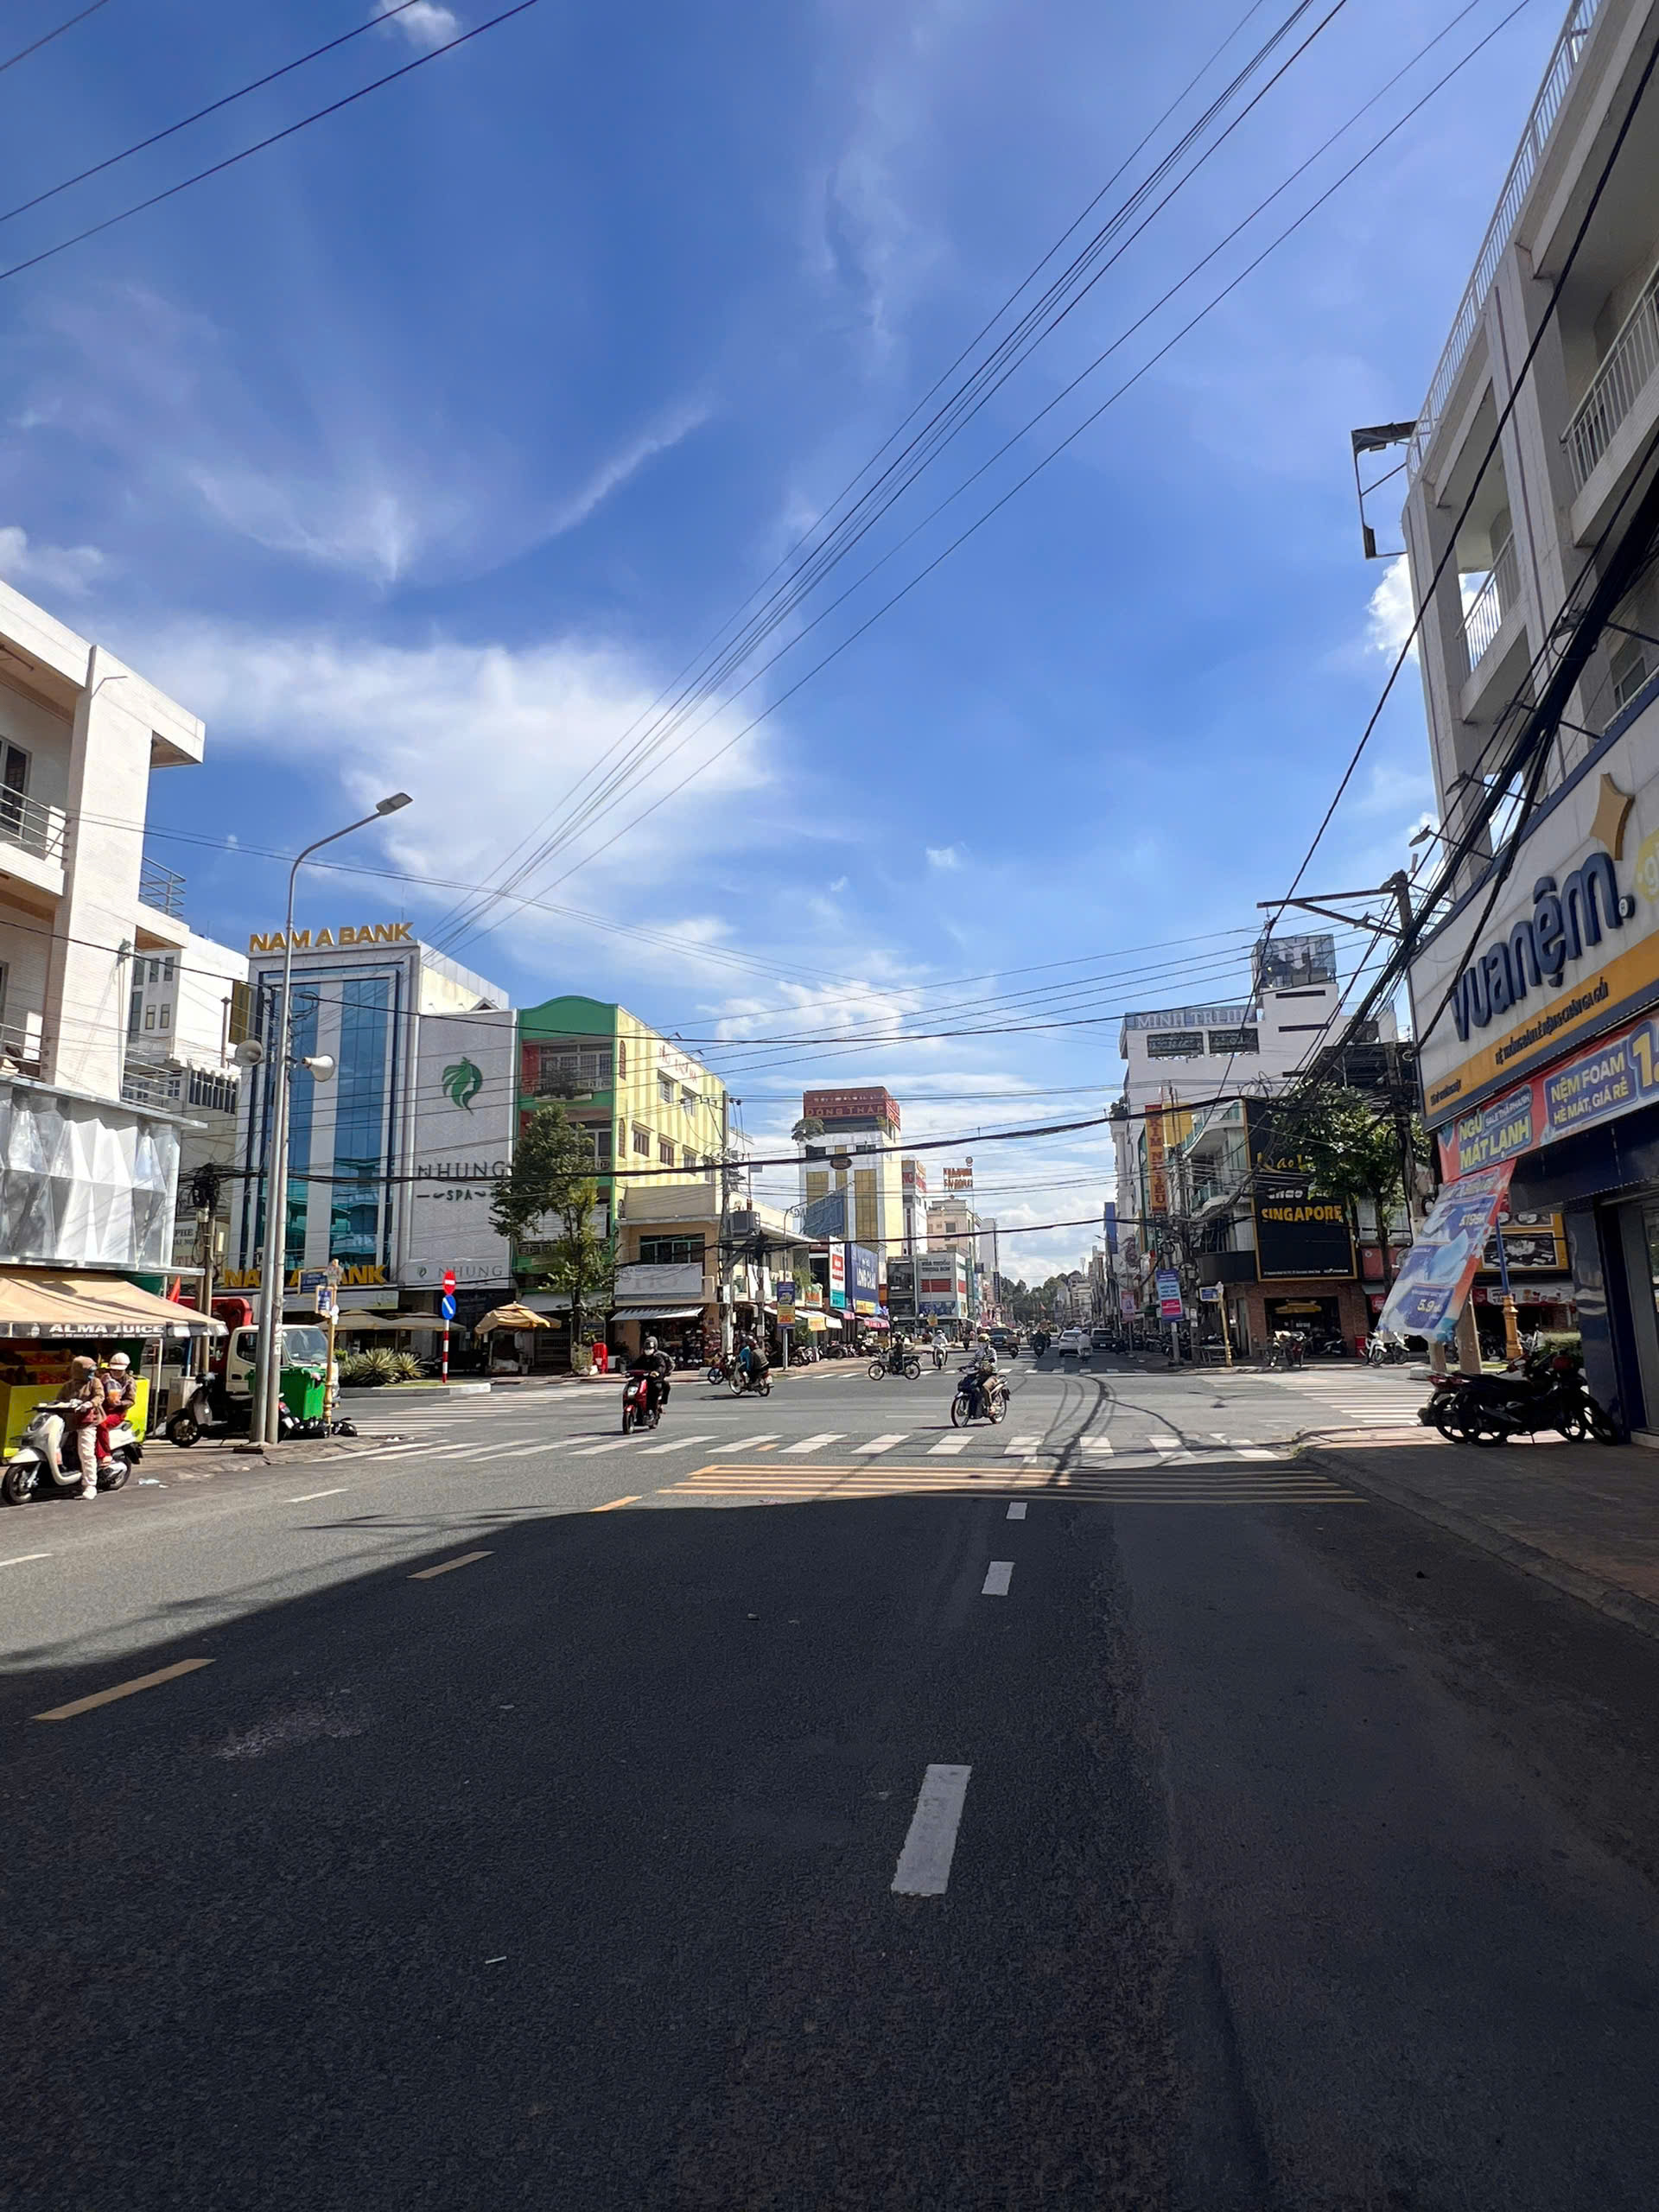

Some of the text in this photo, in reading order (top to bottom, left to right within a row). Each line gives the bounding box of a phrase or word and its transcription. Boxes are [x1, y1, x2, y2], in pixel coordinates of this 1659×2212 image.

[250, 922, 414, 951] NAM A BANK
[1550, 1052, 1625, 1104] NỆM FOAM
[1592, 1084, 1614, 1108] GIÁ
[1613, 1076, 1630, 1100] RẺ
[1459, 1116, 1529, 1170] MÁT LẠNH
[418, 1160, 506, 1178] NHUNG
[446, 1189, 472, 1201] SPA
[1262, 1205, 1343, 1223] SINGAPORE
[49, 1324, 165, 1333] ALMA JUICE
